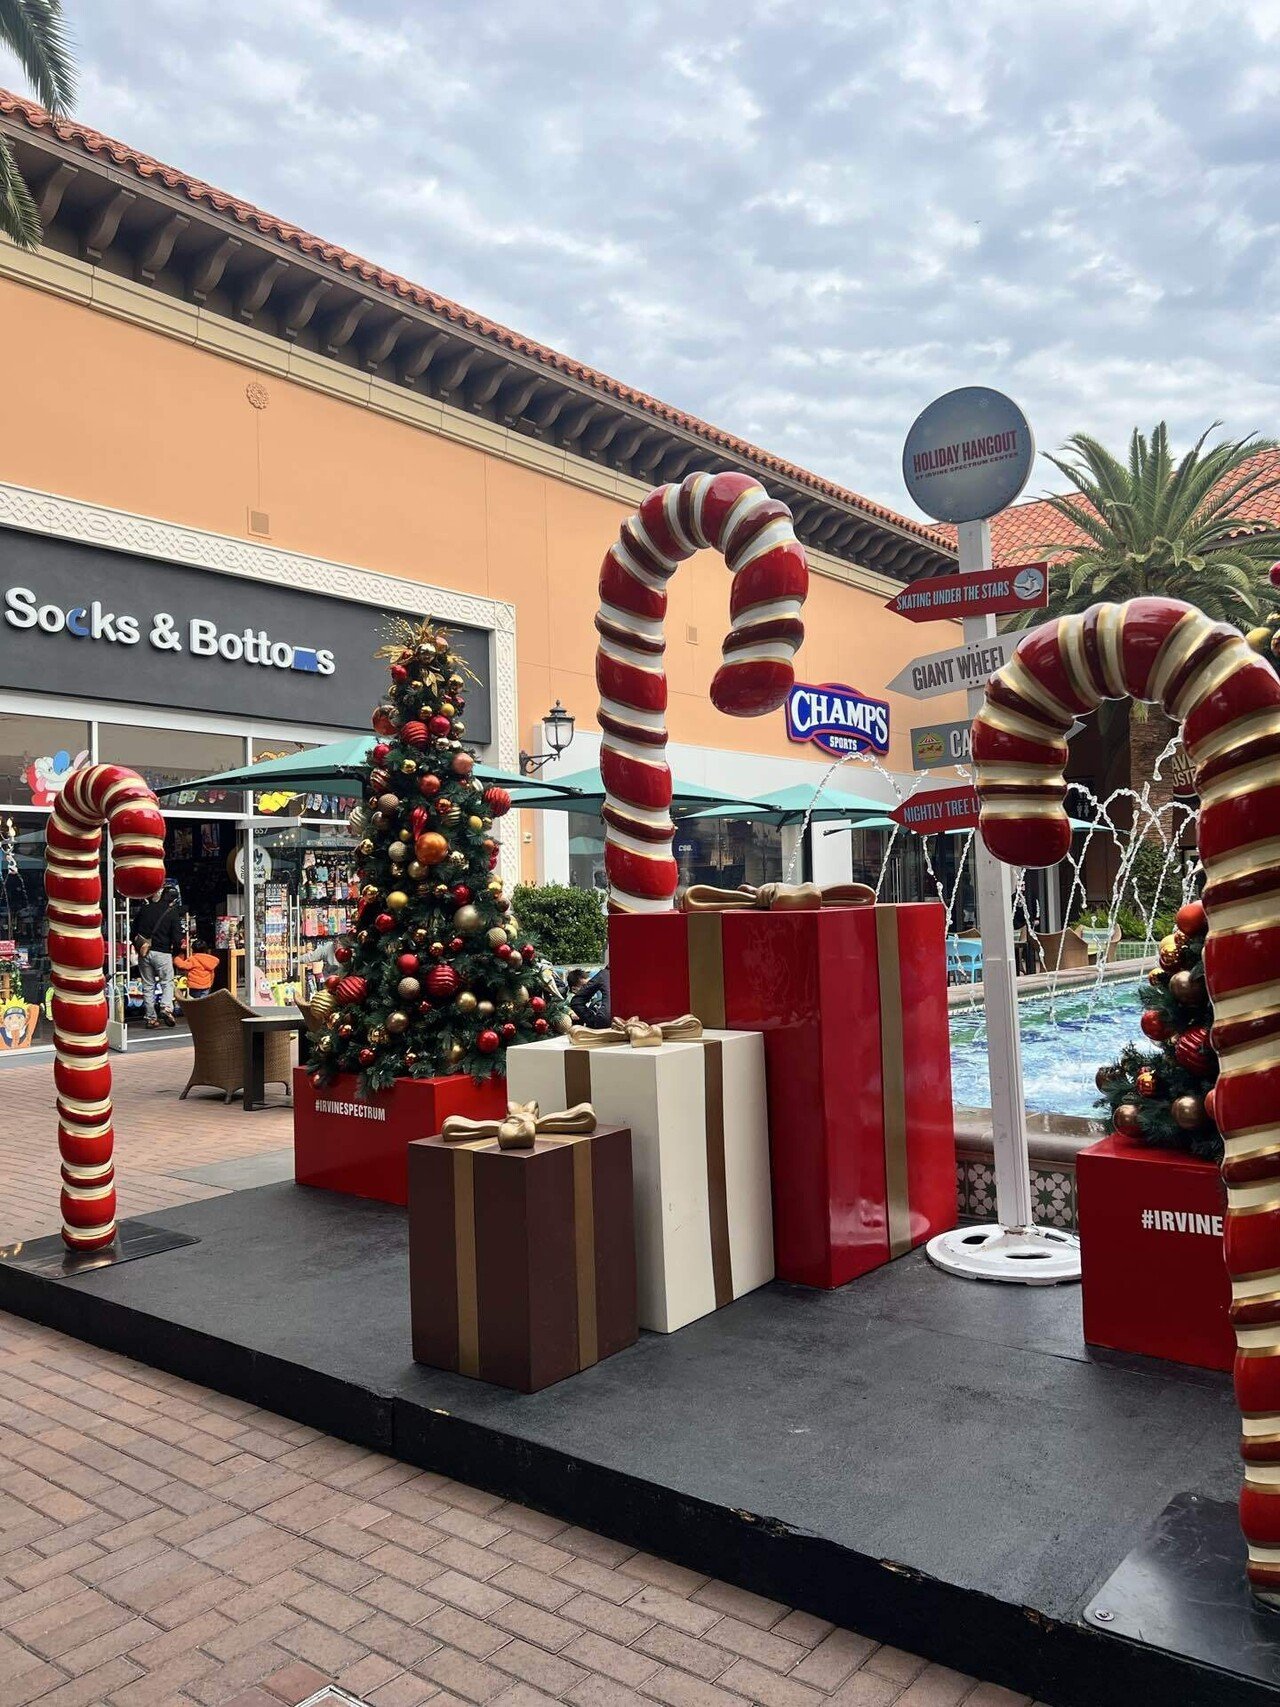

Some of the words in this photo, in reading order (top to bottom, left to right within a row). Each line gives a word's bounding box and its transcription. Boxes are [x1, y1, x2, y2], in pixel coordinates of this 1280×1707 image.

[913, 444, 959, 473] HOLIDAY
[962, 431, 1017, 461] HANGOUT
[925, 468, 948, 478] IRVINE
[950, 459, 988, 472] SPECTRUM
[990, 452, 1018, 463] CENTER
[896, 592, 931, 610] SKATING
[933, 589, 962, 605] UNDER
[963, 585, 979, 601] THE
[982, 581, 1010, 599] STARS
[5, 587, 140, 644] Socks
[150, 612, 182, 652] &
[912, 658, 953, 691] GIANT
[791, 690, 888, 744] CHAMPS
[829, 736, 858, 751] SPORTS
[950, 727, 971, 758] CA
[904, 801, 943, 823] NIGHTLY
[944, 797, 970, 817] TREE
[315, 1099, 386, 1121] #IRVINESPECTRUM
[1141, 1209, 1224, 1237] #IRVINE
